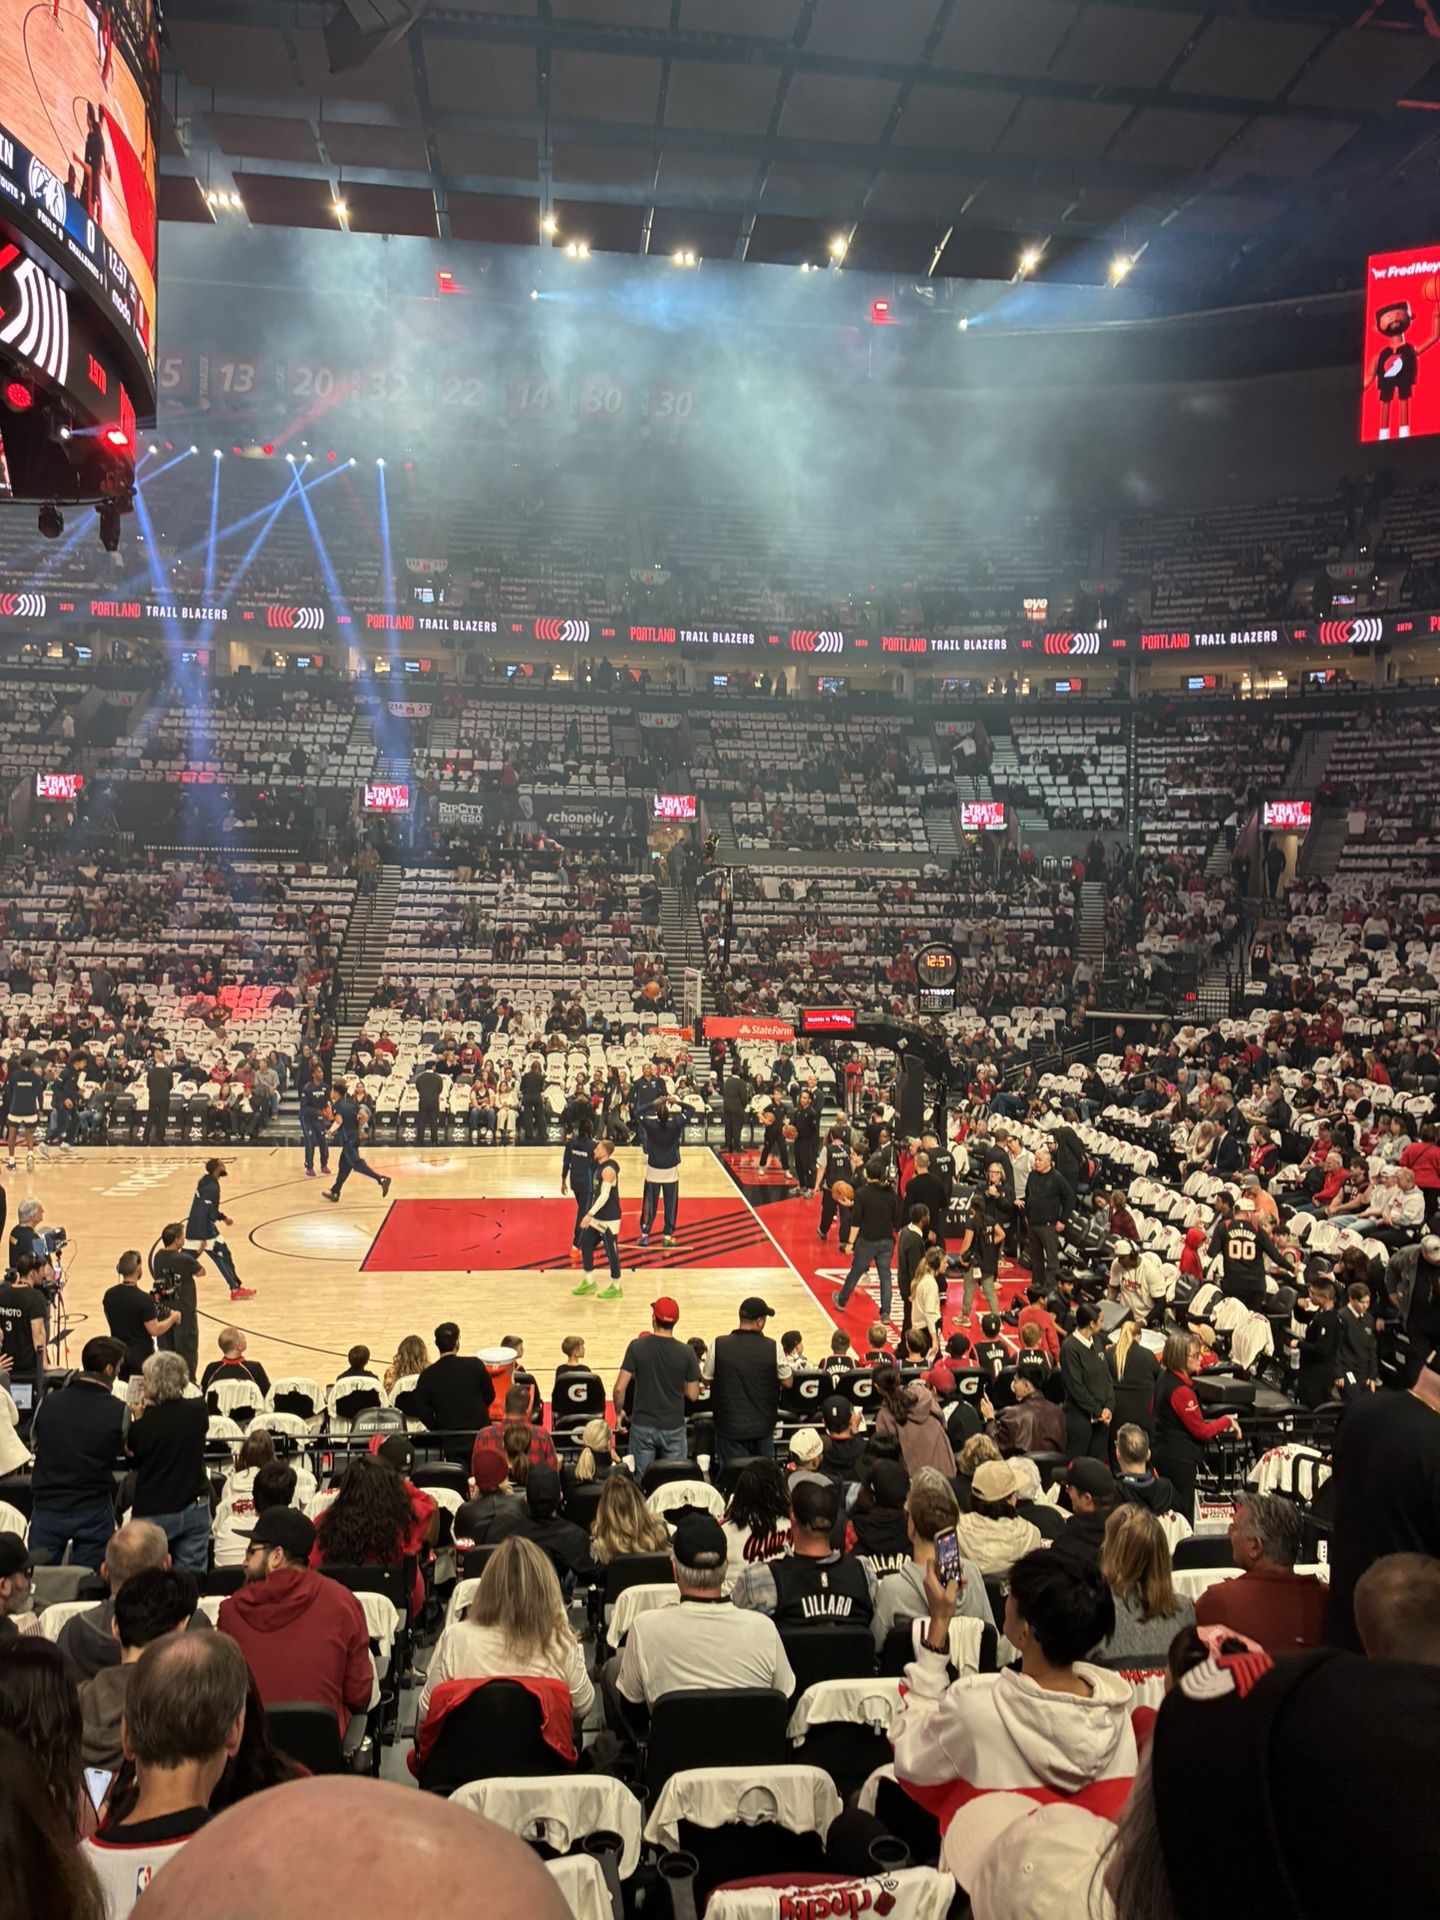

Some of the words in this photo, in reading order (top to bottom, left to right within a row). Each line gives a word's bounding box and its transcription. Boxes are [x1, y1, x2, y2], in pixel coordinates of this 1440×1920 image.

[221, 363, 254, 392] 13
[294, 368, 333, 397] 20
[443, 378, 482, 407] 22
[655, 390, 693, 417] 30
[90, 601, 141, 618] PORTLAND
[146, 605, 177, 618] TRAIL
[181, 606, 227, 620] BLAZERS
[366, 614, 414, 630] PORTLAND
[419, 617, 449, 630] TRAIL
[453, 619, 497, 632] BLAZERS
[1430, 615, 1440, 631] P
[630, 626, 676, 642] PORTLAND
[680, 630, 709, 643] TRAIL
[712, 631, 755, 645] BLAZERS
[881, 636, 927, 652] PORTLAND
[931, 639, 960, 651] TRAIL
[963, 638, 1007, 651] BLAZERS
[1142, 633, 1190, 650] PORTLAND
[1195, 632, 1226, 646] TRAIL
[1230, 630, 1278, 644] BLAZERS
[927, 955, 952, 967] 12:57
[1229, 1240, 1256, 1260] 00
[5, 1320, 12, 1332] 3
[568, 1383, 587, 1402] G
[801, 1380, 820, 1399] G
[853, 1378, 872, 1398] G
[959, 1376, 979, 1395] G
[802, 1593, 853, 1618] LILLARD
